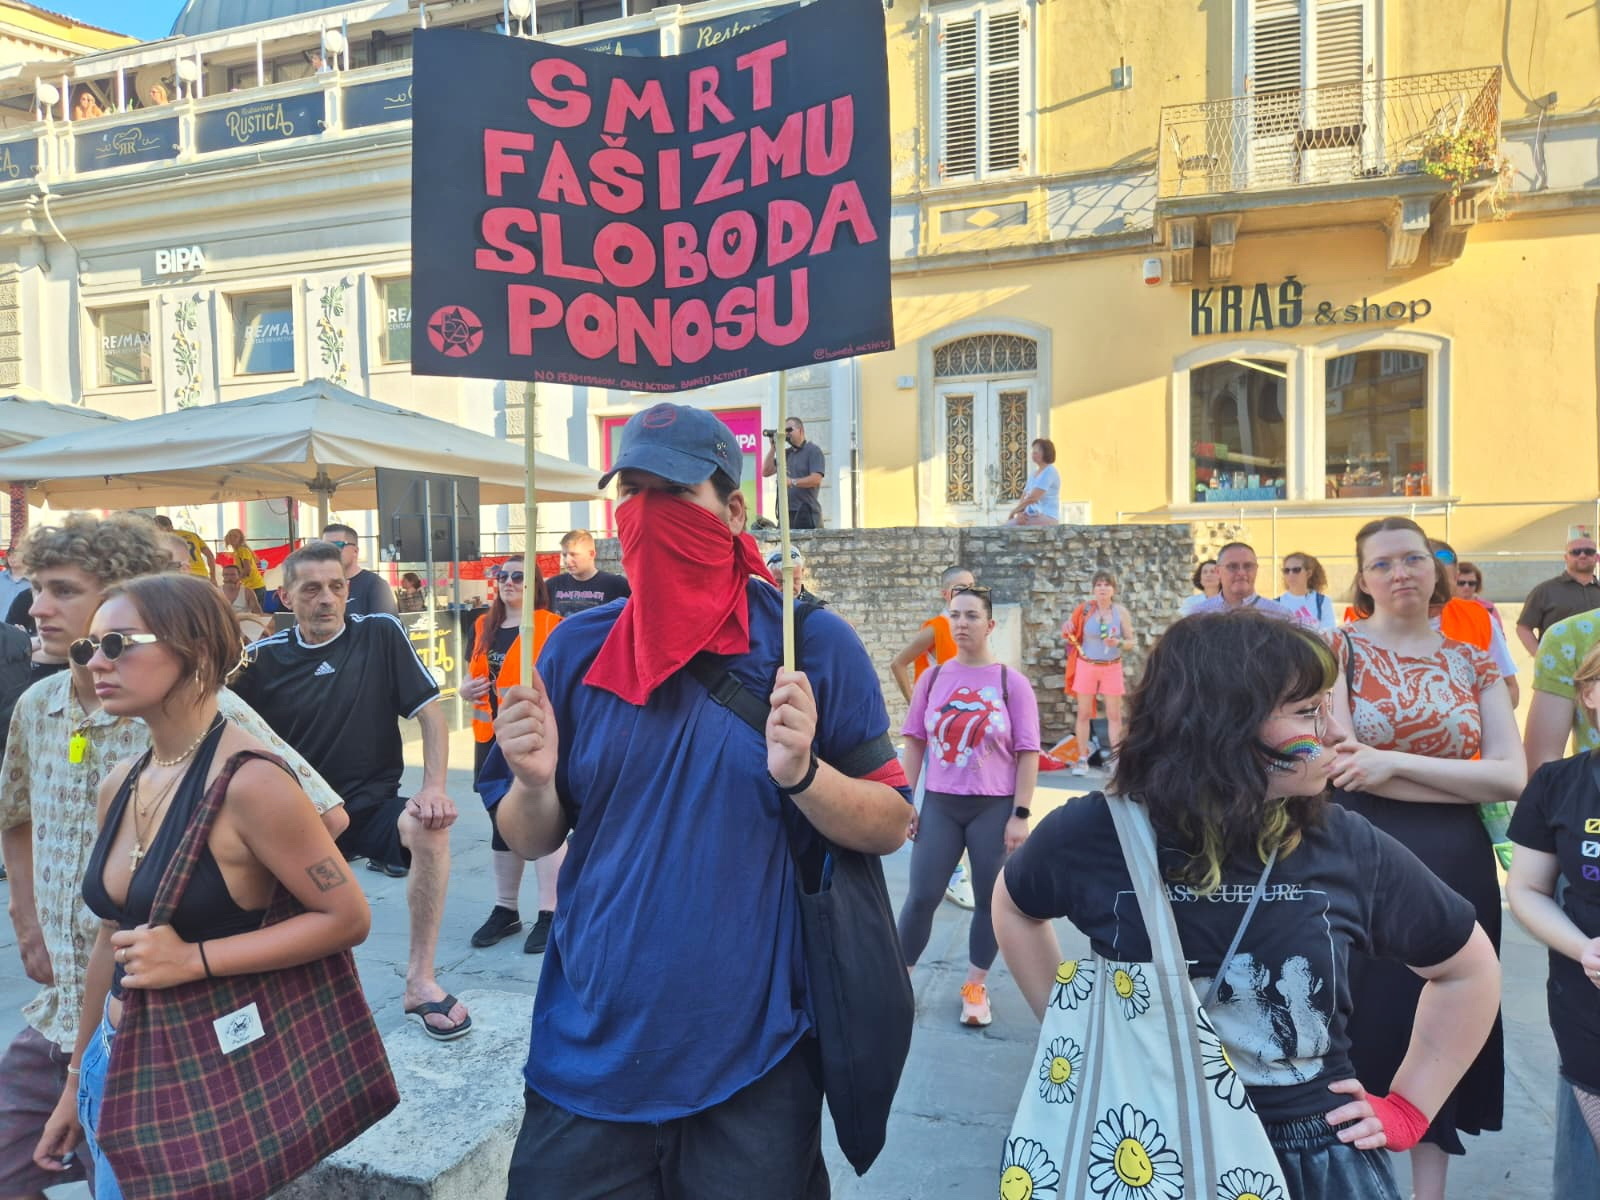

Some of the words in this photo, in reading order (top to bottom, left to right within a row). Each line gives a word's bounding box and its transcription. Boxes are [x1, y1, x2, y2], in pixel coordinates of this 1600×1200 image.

[527, 40, 787, 134] SMRT
[226, 103, 294, 143] RUSTICA
[484, 94, 853, 214] FAŠIZMU
[156, 245, 205, 274] BIPA
[475, 180, 878, 289] SLOBODA
[245, 322, 293, 338] RE/MA
[507, 267, 809, 367] PONOSU
[1191, 275, 1303, 336] KRAŠ
[104, 333, 151, 349] RE/MAX
[534, 370, 555, 381] NO
